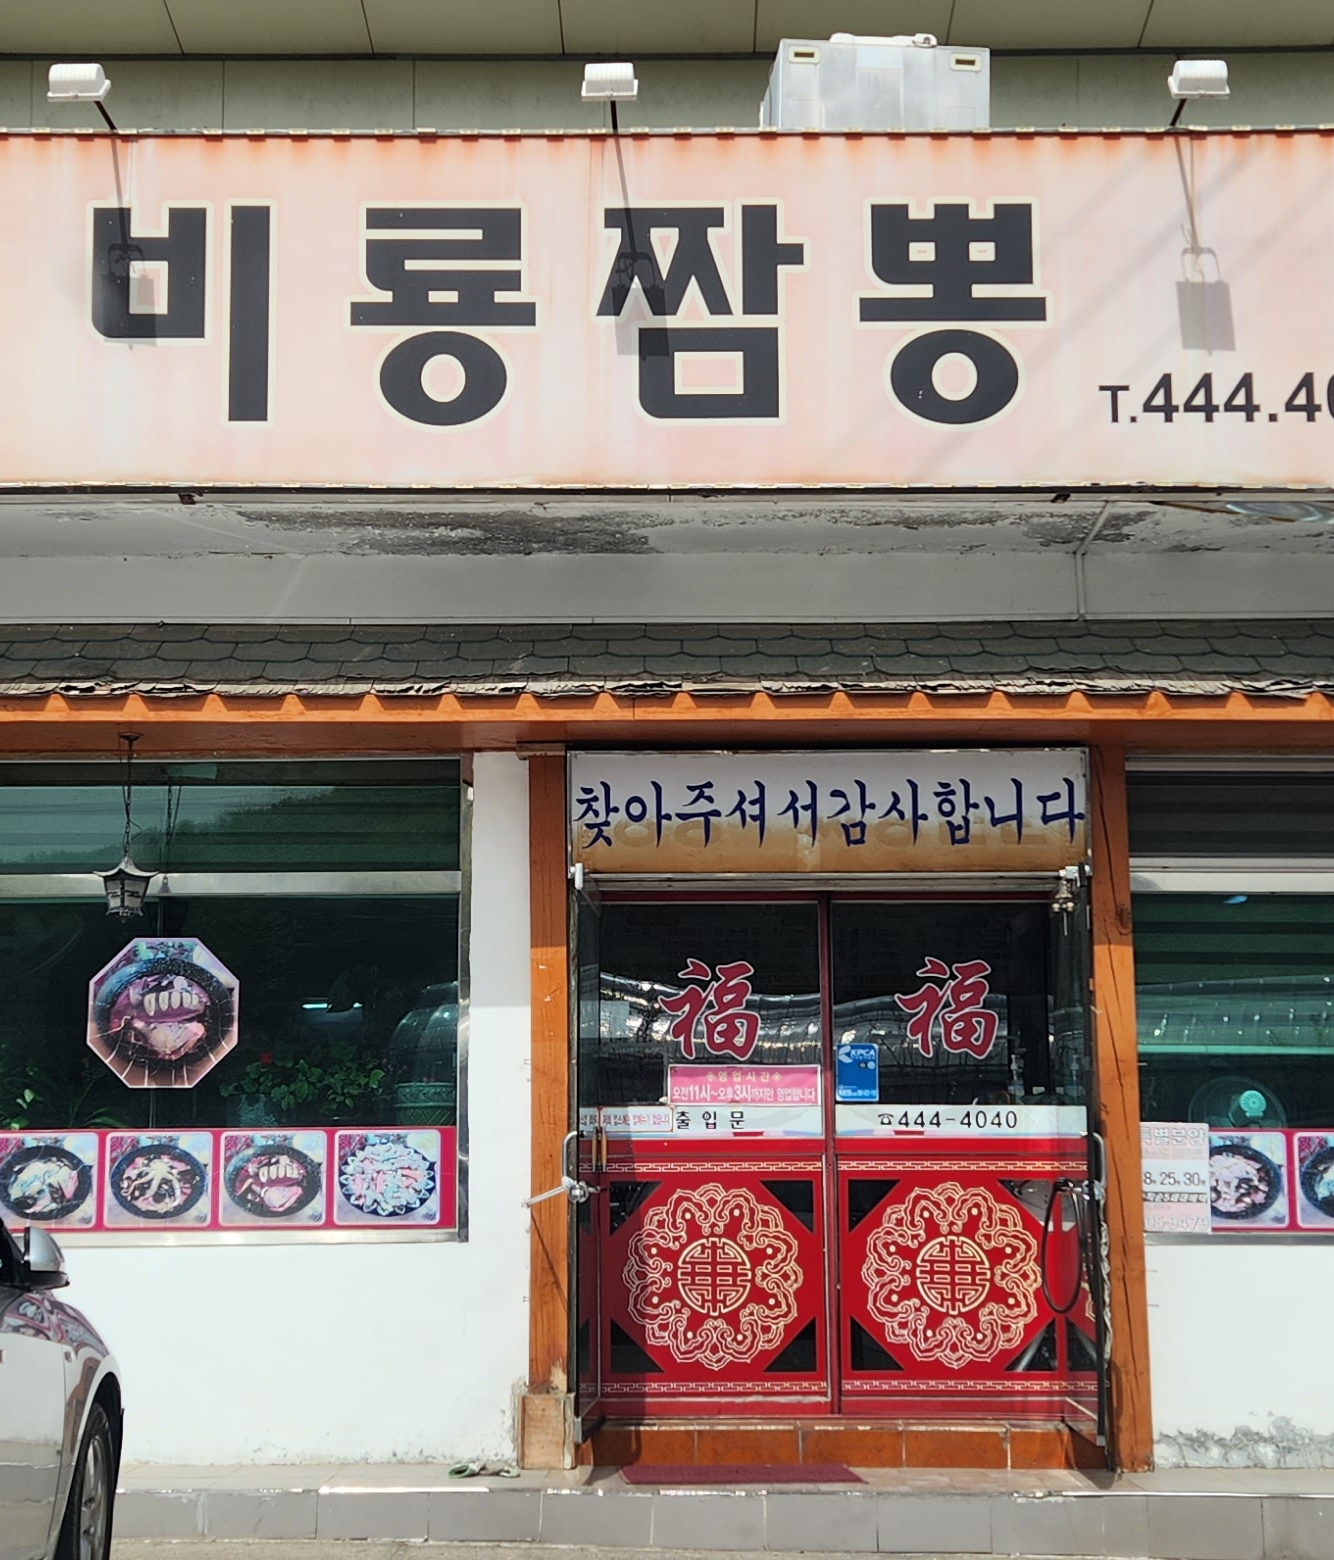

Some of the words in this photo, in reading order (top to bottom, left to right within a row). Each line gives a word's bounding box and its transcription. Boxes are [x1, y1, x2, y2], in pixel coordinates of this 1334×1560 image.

[91, 202, 1048, 427] 비룡짬뽕
[658, 958, 761, 1061] 福
[894, 956, 999, 1060] 福
